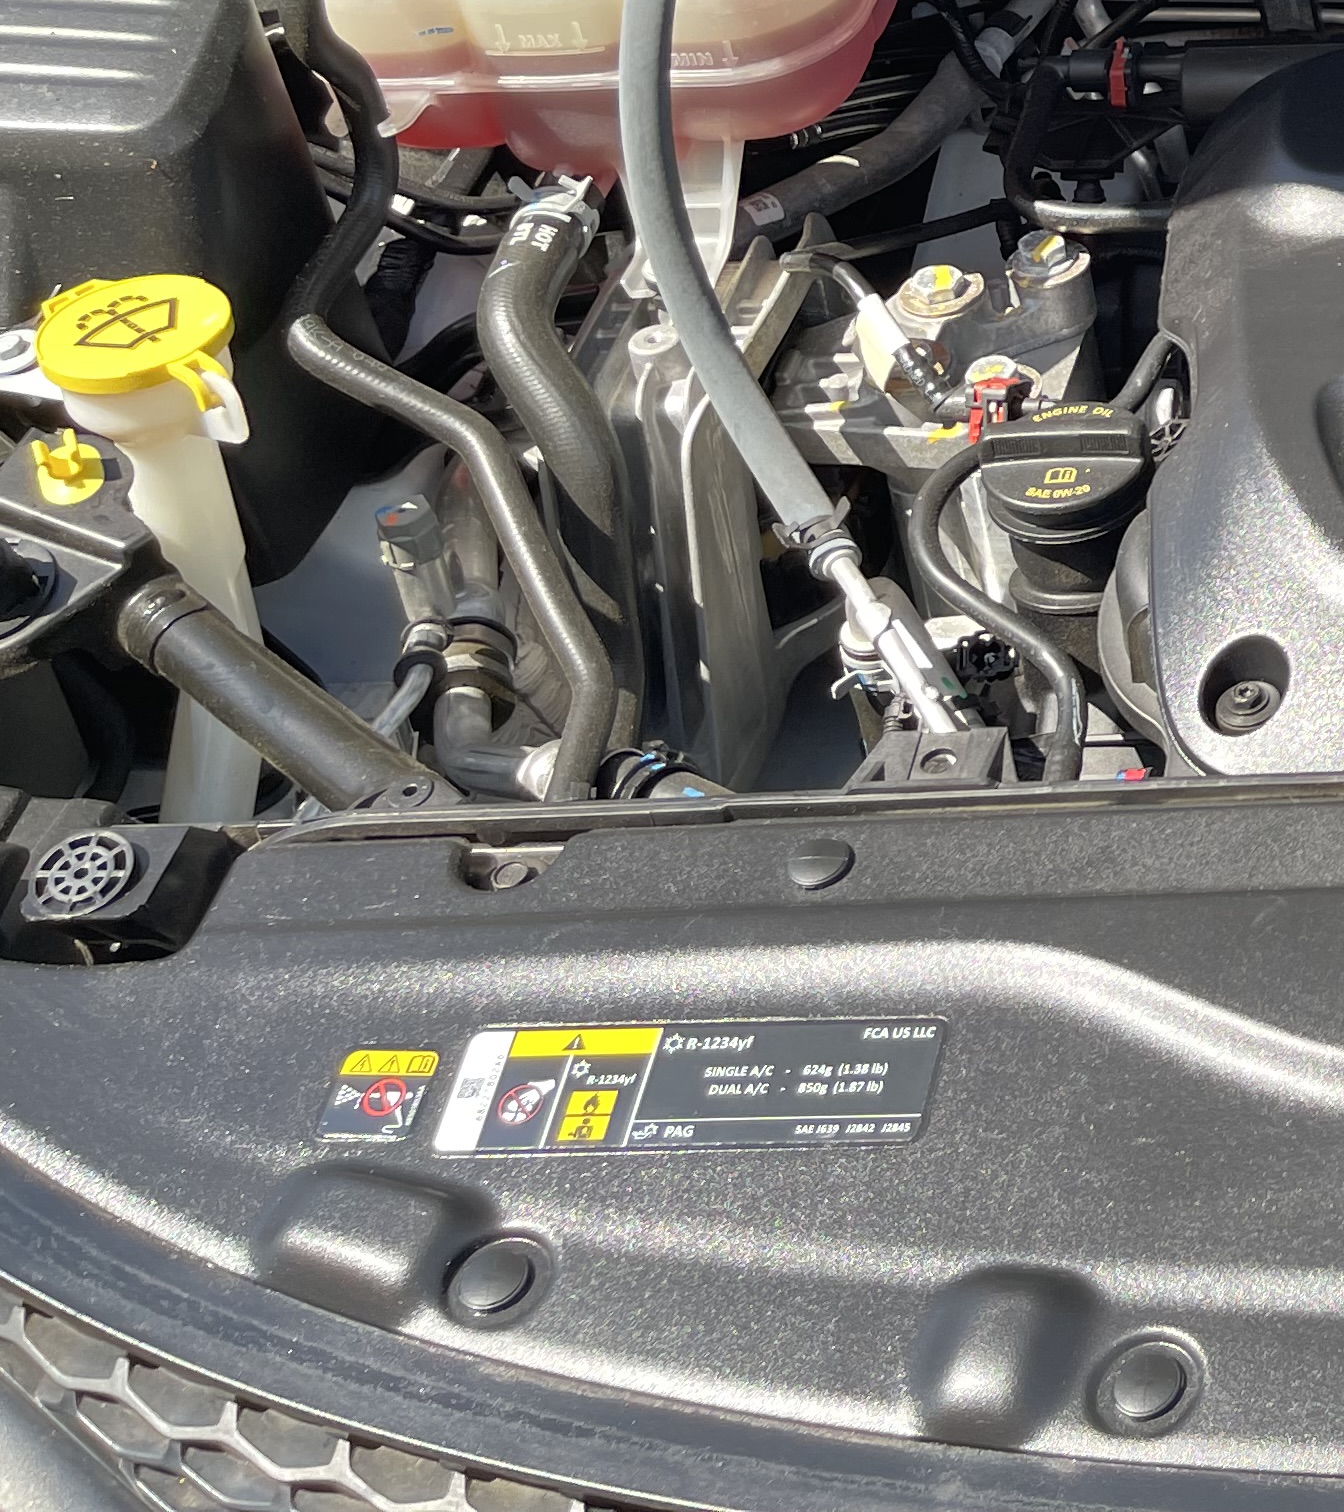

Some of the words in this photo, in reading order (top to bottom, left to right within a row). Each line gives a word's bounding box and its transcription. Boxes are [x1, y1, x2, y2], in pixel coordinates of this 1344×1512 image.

[518, 33, 562, 49] MAX
[531, 223, 559, 252] HOT
[1032, 405, 1088, 422] ENGINE
[1092, 406, 1114, 418] OIL
[1025, 486, 1052, 498] SAE
[1053, 484, 1091, 498] 0W-20
[863, 1027, 888, 1039] FCA
[892, 1027, 911, 1039] US
[913, 1026, 937, 1038] LLC
[686, 1036, 754, 1052] R-1234yf
[704, 1066, 748, 1077] SINGLE
[750, 1065, 774, 1077] A/C
[802, 1065, 833, 1078] 624g
[837, 1063, 869, 1076] (1.38
[871, 1062, 888, 1076] lb)
[586, 1073, 637, 1086] R-1234yf
[708, 1084, 741, 1095] DUAL
[744, 1082, 769, 1095] A/C
[797, 1083, 827, 1096] 850g
[832, 1081, 865, 1095] (1.87
[866, 1081, 884, 1094] lb)
[664, 1125, 694, 1137] PAG
[794, 1124, 814, 1135] SAE
[845, 1123, 876, 1133] J2842
[881, 1122, 911, 1133] J2845
